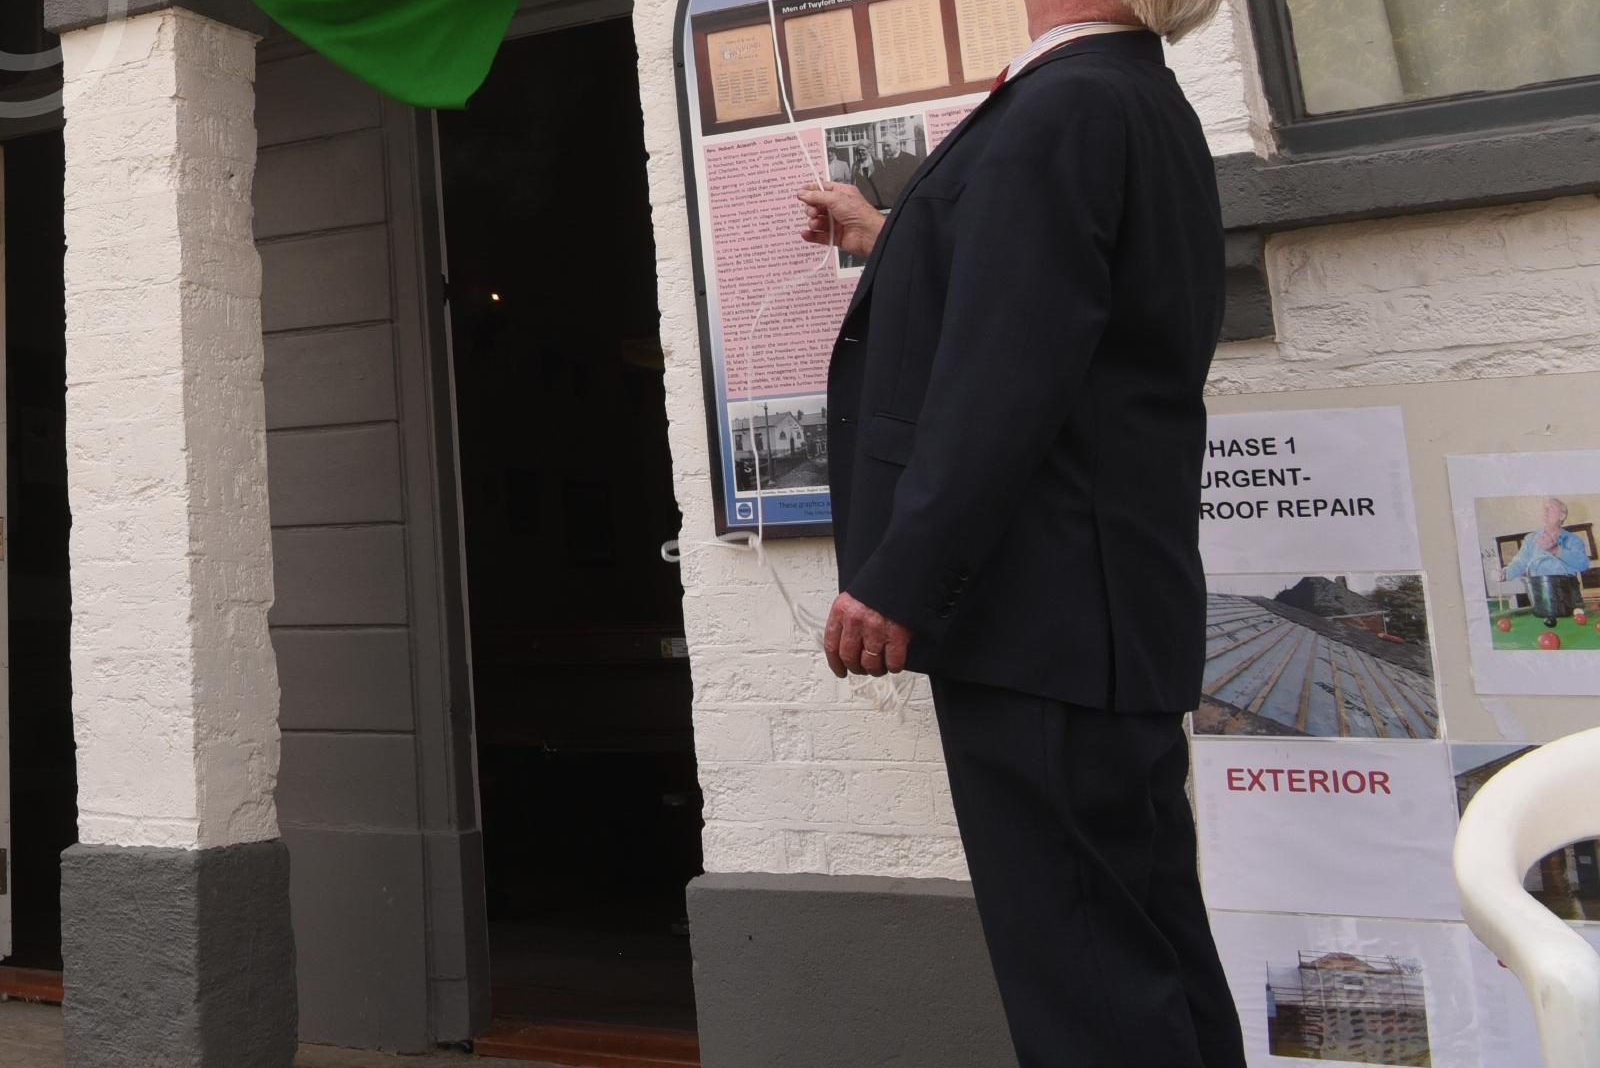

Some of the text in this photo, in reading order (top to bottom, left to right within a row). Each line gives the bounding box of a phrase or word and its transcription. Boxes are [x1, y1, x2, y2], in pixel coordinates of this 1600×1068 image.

[782, 5, 798, 14] Men
[799, 3, 807, 11] of
[1206, 437, 1296, 458] HASE 1
[1200, 498, 1376, 520] ROOF REPAIR
[1227, 768, 1391, 795] EXTERIOR
